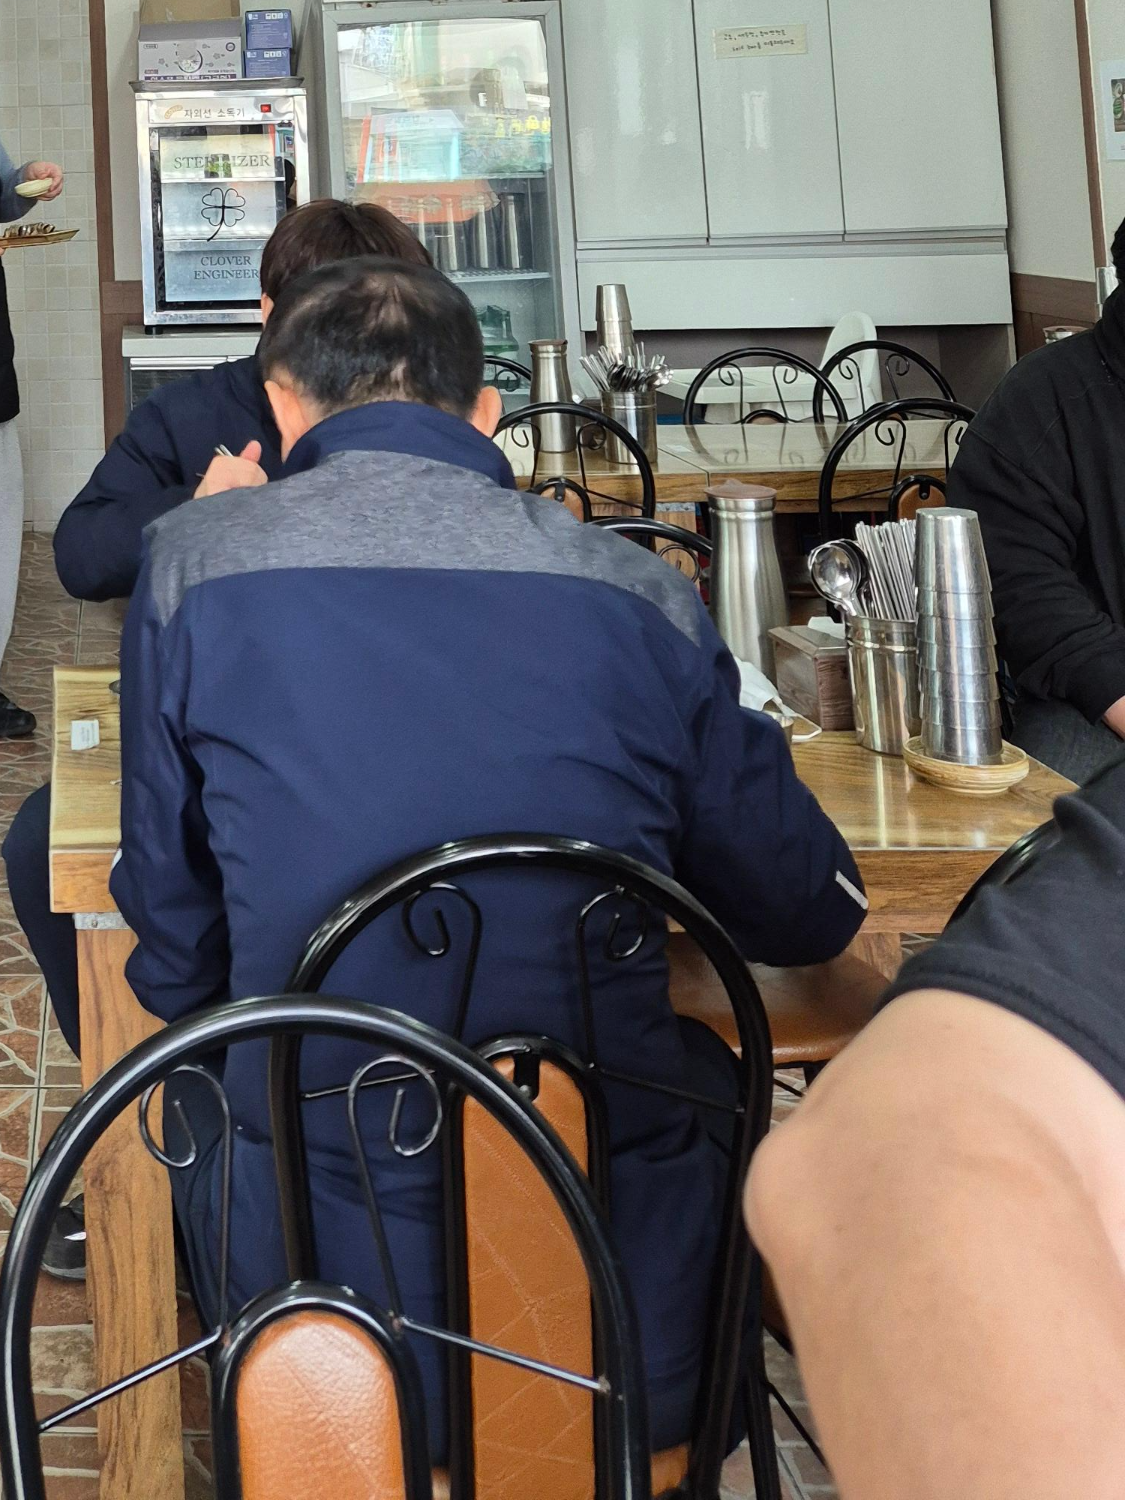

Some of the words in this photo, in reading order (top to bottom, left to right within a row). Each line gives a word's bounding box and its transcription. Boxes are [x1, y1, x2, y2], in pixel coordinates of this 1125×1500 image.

[184, 108, 212, 119] 자외선
[217, 107, 246, 118] 소독기
[201, 256, 252, 266] CLOVER
